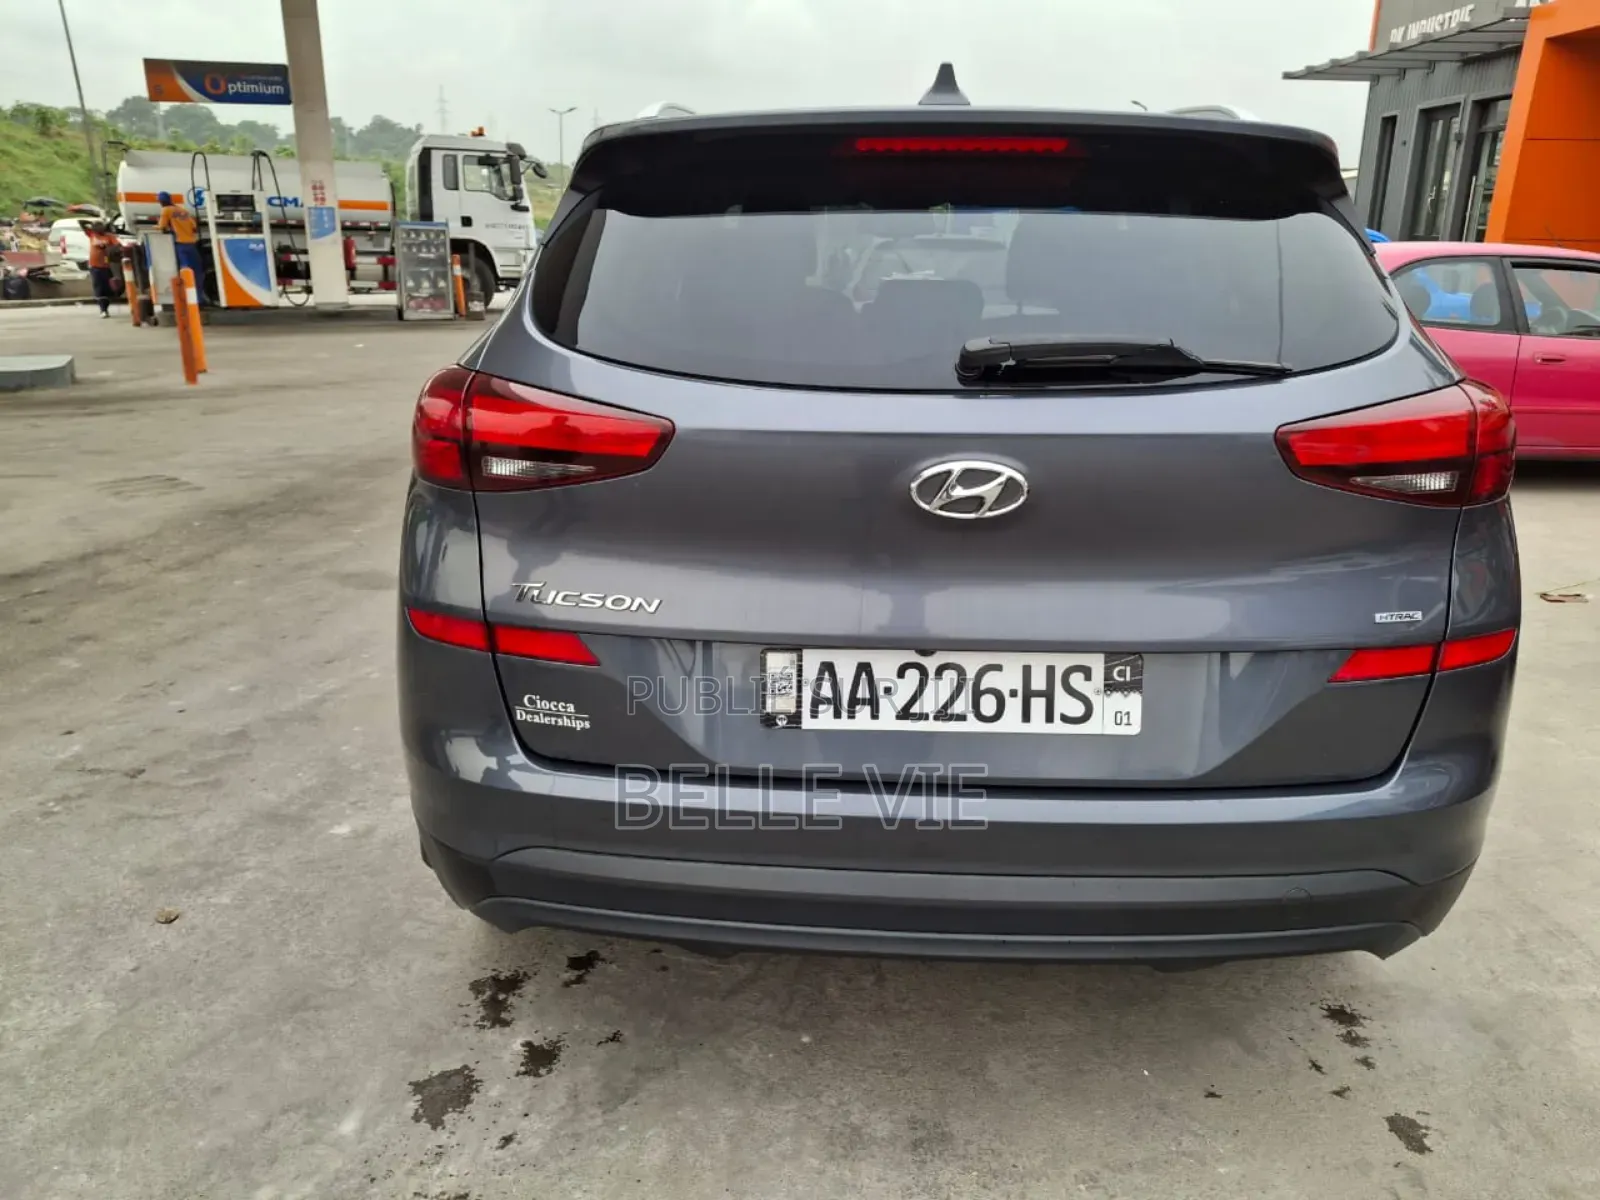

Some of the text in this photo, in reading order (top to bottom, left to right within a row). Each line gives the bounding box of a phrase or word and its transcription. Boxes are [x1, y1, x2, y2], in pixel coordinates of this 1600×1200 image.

[204, 72, 285, 95] Optimium
[267, 196, 303, 208] CM
[1113, 665, 1131, 682] CI
[523, 694, 576, 713] Ciocca
[515, 709, 591, 731] Dealerships
[1114, 710, 1133, 726] 01
